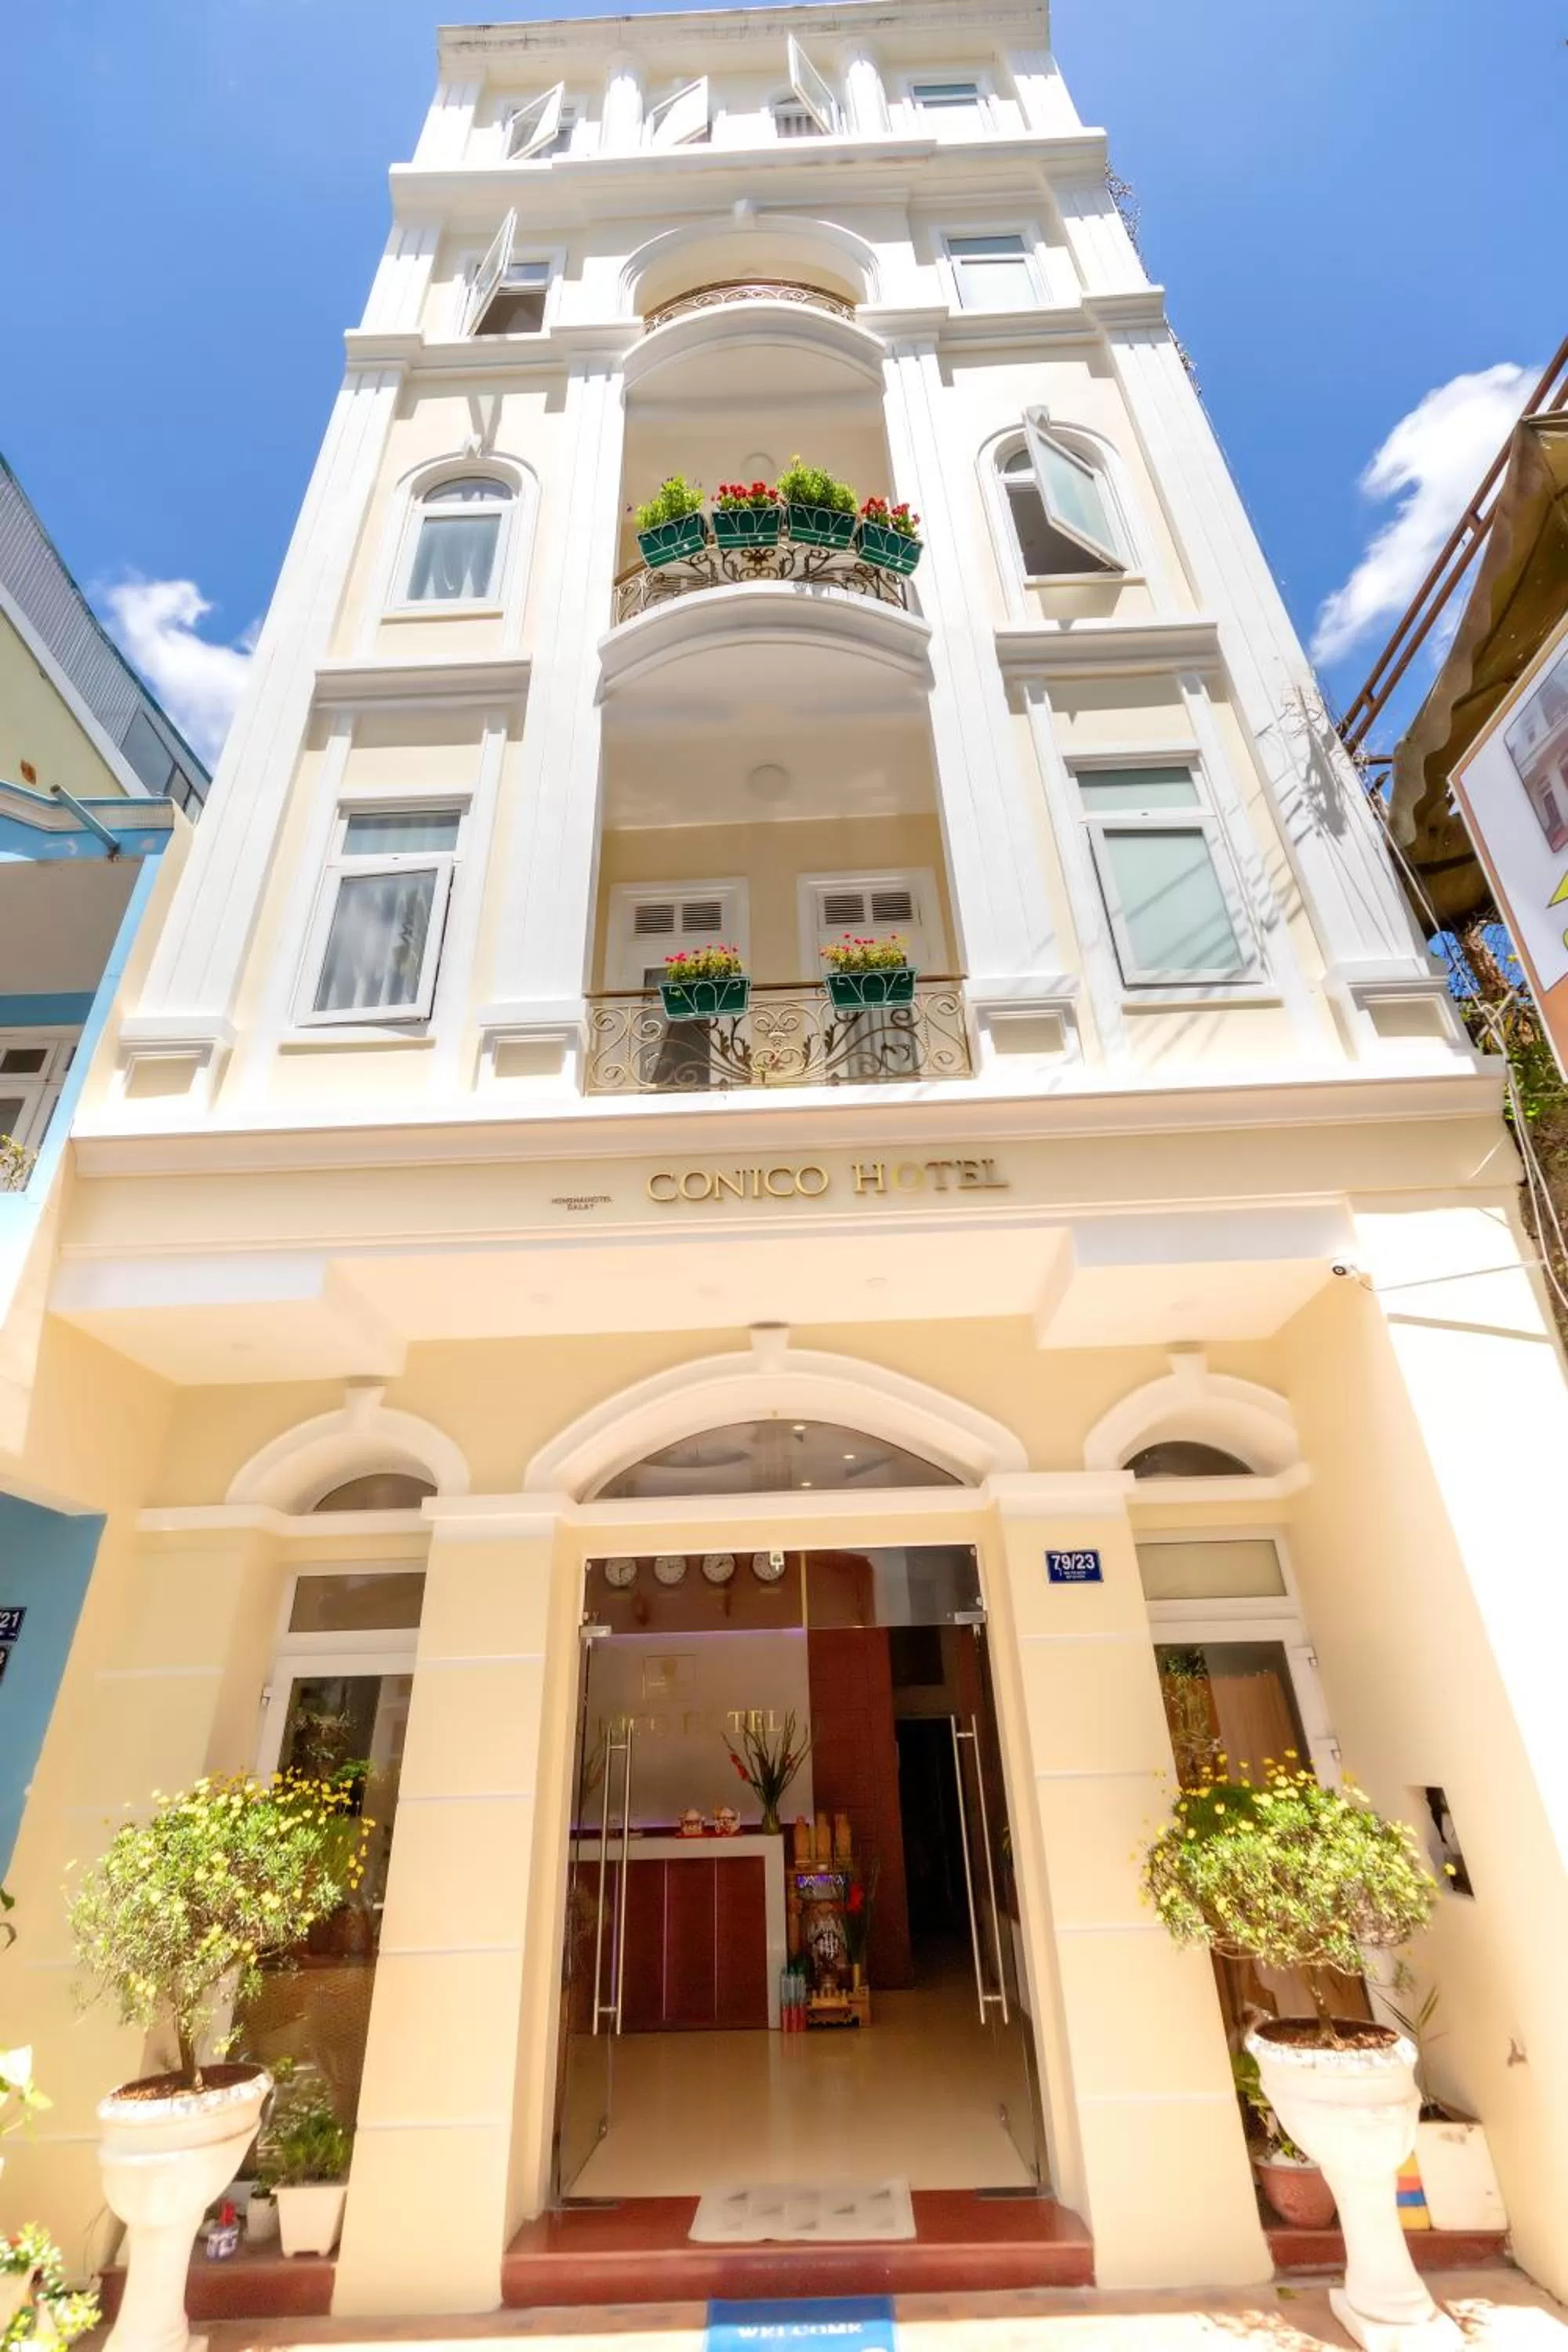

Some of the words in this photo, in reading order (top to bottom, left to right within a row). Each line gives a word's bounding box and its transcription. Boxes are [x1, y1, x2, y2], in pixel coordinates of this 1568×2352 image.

[647, 1166, 829, 1201] CONICO
[851, 1159, 1010, 1194] HOTEL
[1051, 1553, 1095, 1570] 79/23
[0, 1611, 20, 1628] 21
